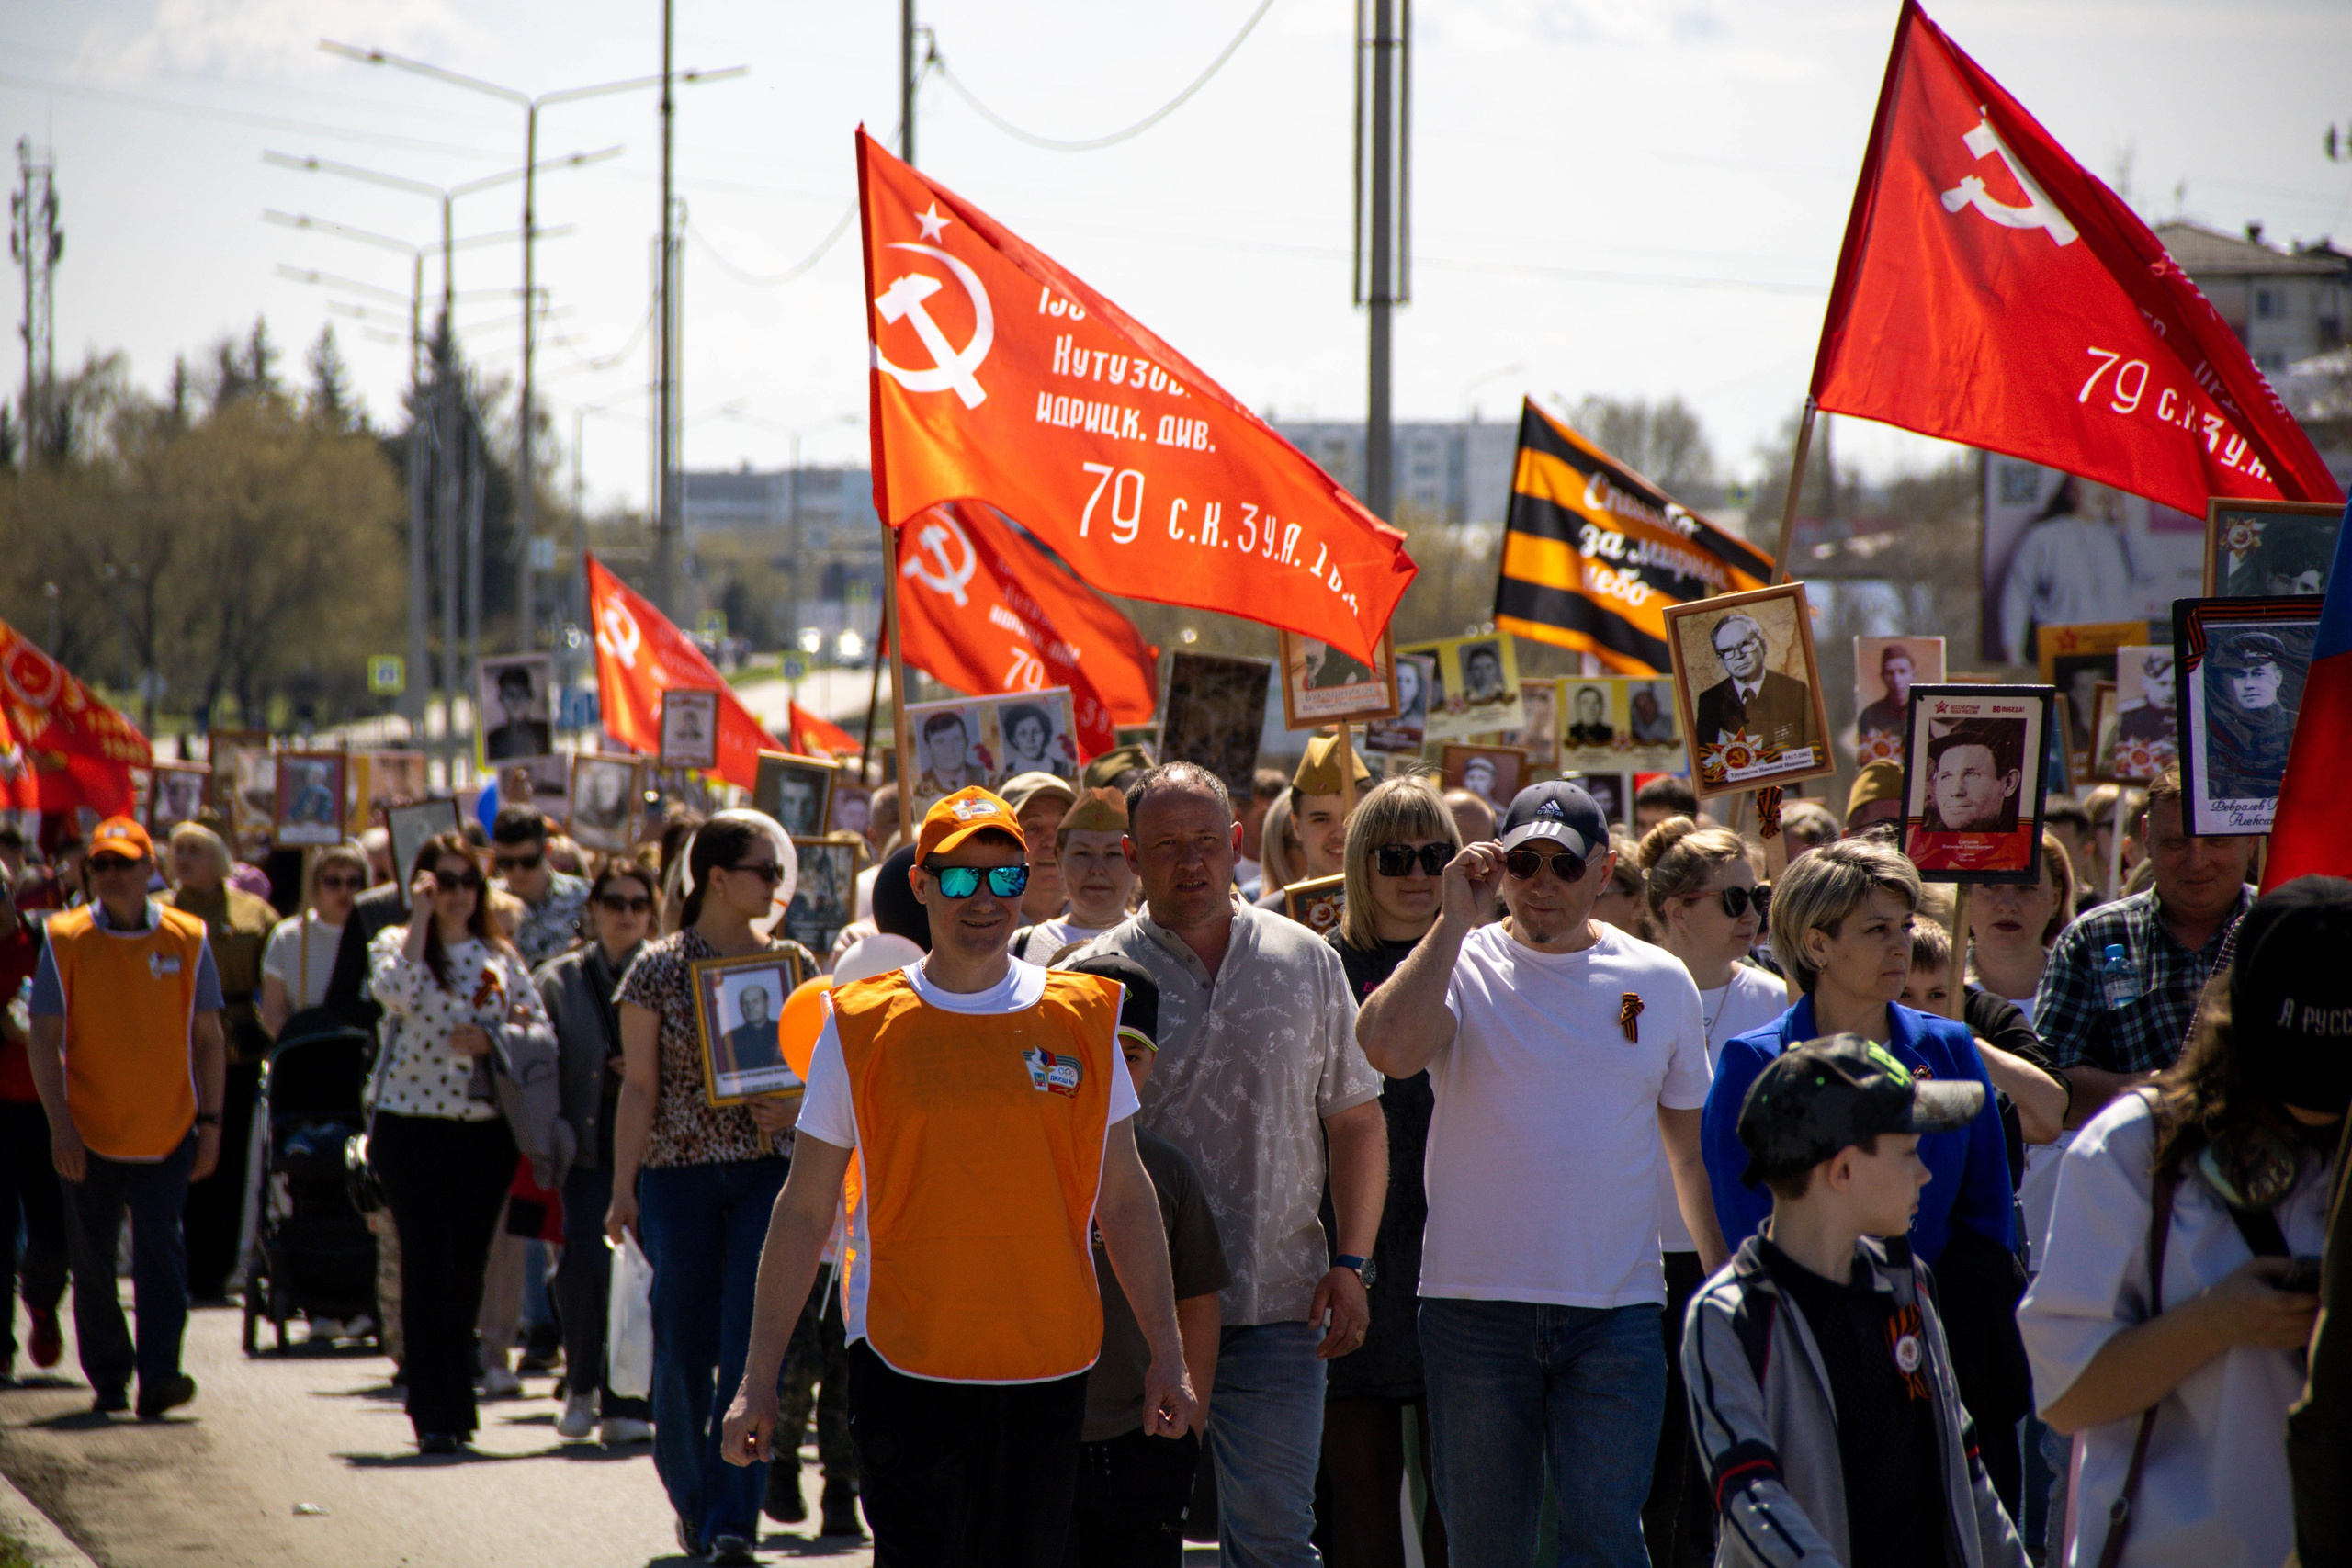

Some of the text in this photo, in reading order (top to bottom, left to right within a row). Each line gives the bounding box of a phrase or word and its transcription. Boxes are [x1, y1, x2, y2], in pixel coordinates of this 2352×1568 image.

[2077, 345, 2151, 415] 79
[1079, 460, 1146, 545] 79
[1578, 522, 1626, 559] за
[1992, 705, 2001, 714] 80
[2002, 705, 2025, 714] ПОБЕДА!
[1536, 807, 1564, 817] adidas
